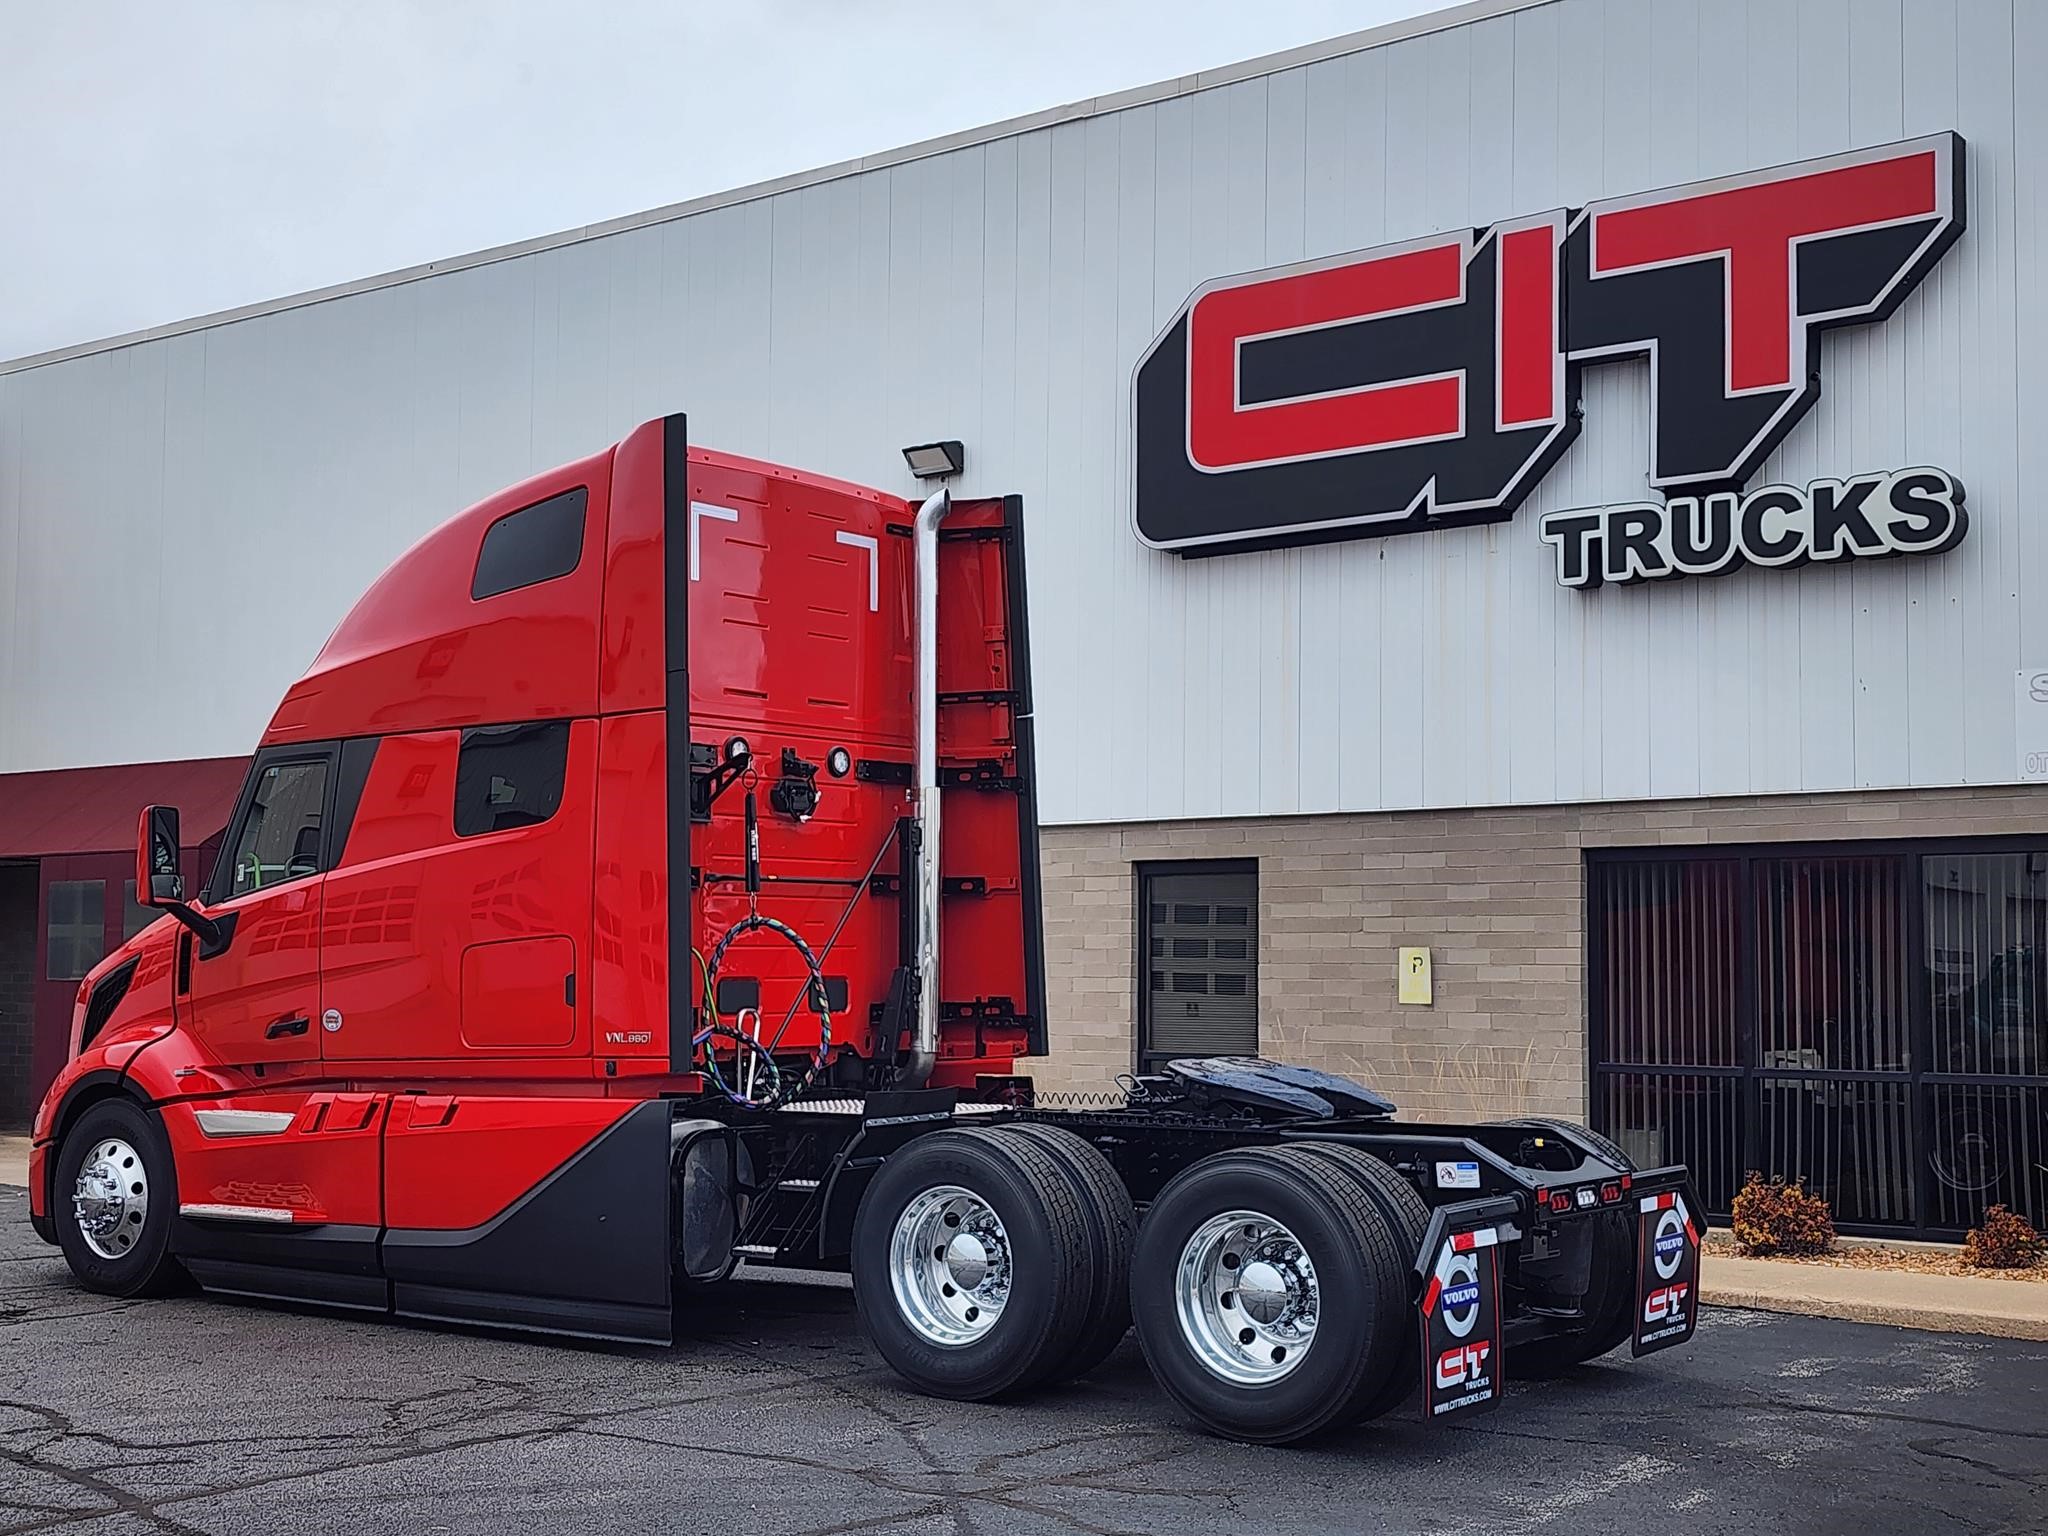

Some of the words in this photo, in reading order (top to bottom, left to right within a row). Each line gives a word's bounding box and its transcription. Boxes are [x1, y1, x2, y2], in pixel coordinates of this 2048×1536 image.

[1186, 138, 1945, 474] CIT
[1545, 474, 1957, 581] TRUCKS
[1656, 1237, 1683, 1252] VOLVO
[1443, 1287, 1478, 1305] VOLVO
[1666, 1313, 1686, 1324] TRUCKS
[1465, 1376, 1490, 1391] TRUCKS
